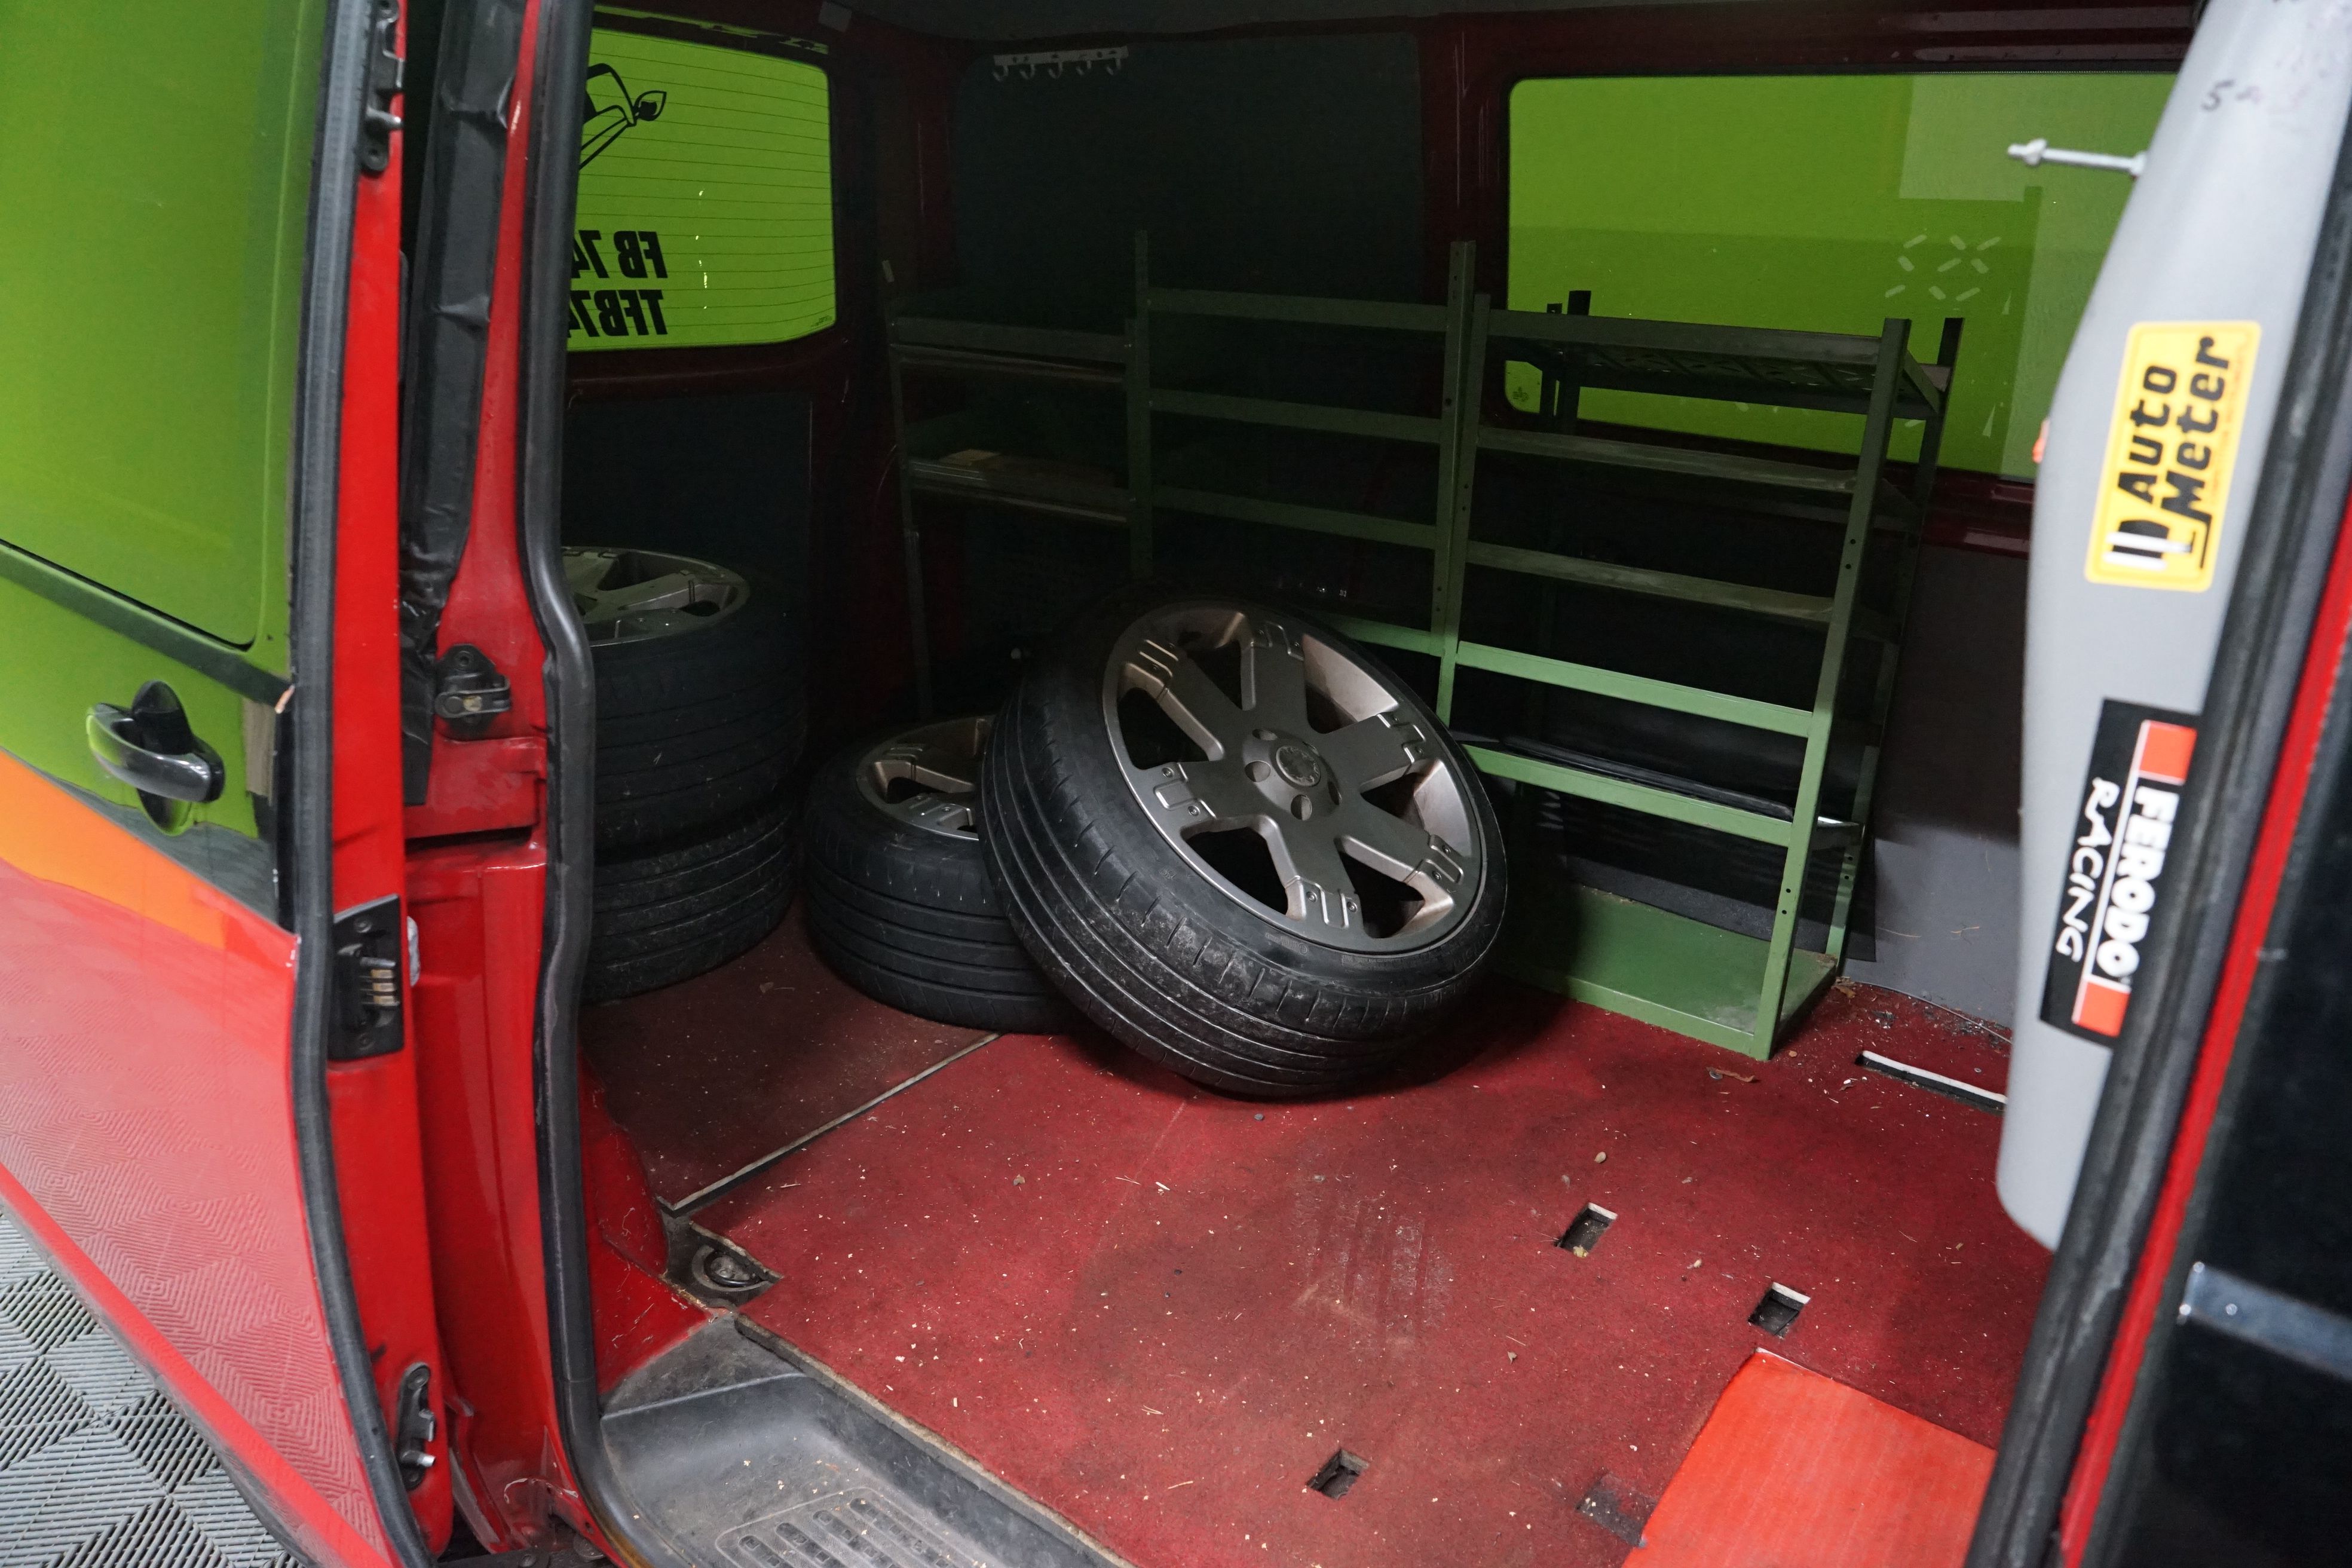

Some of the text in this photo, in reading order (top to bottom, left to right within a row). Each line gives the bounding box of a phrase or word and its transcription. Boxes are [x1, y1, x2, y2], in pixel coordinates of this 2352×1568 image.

[2117, 365, 2177, 504] Auto
[2160, 336, 2230, 520] Meter
[2056, 777, 2120, 962] RACING
[2096, 788, 2180, 978] FERODO
